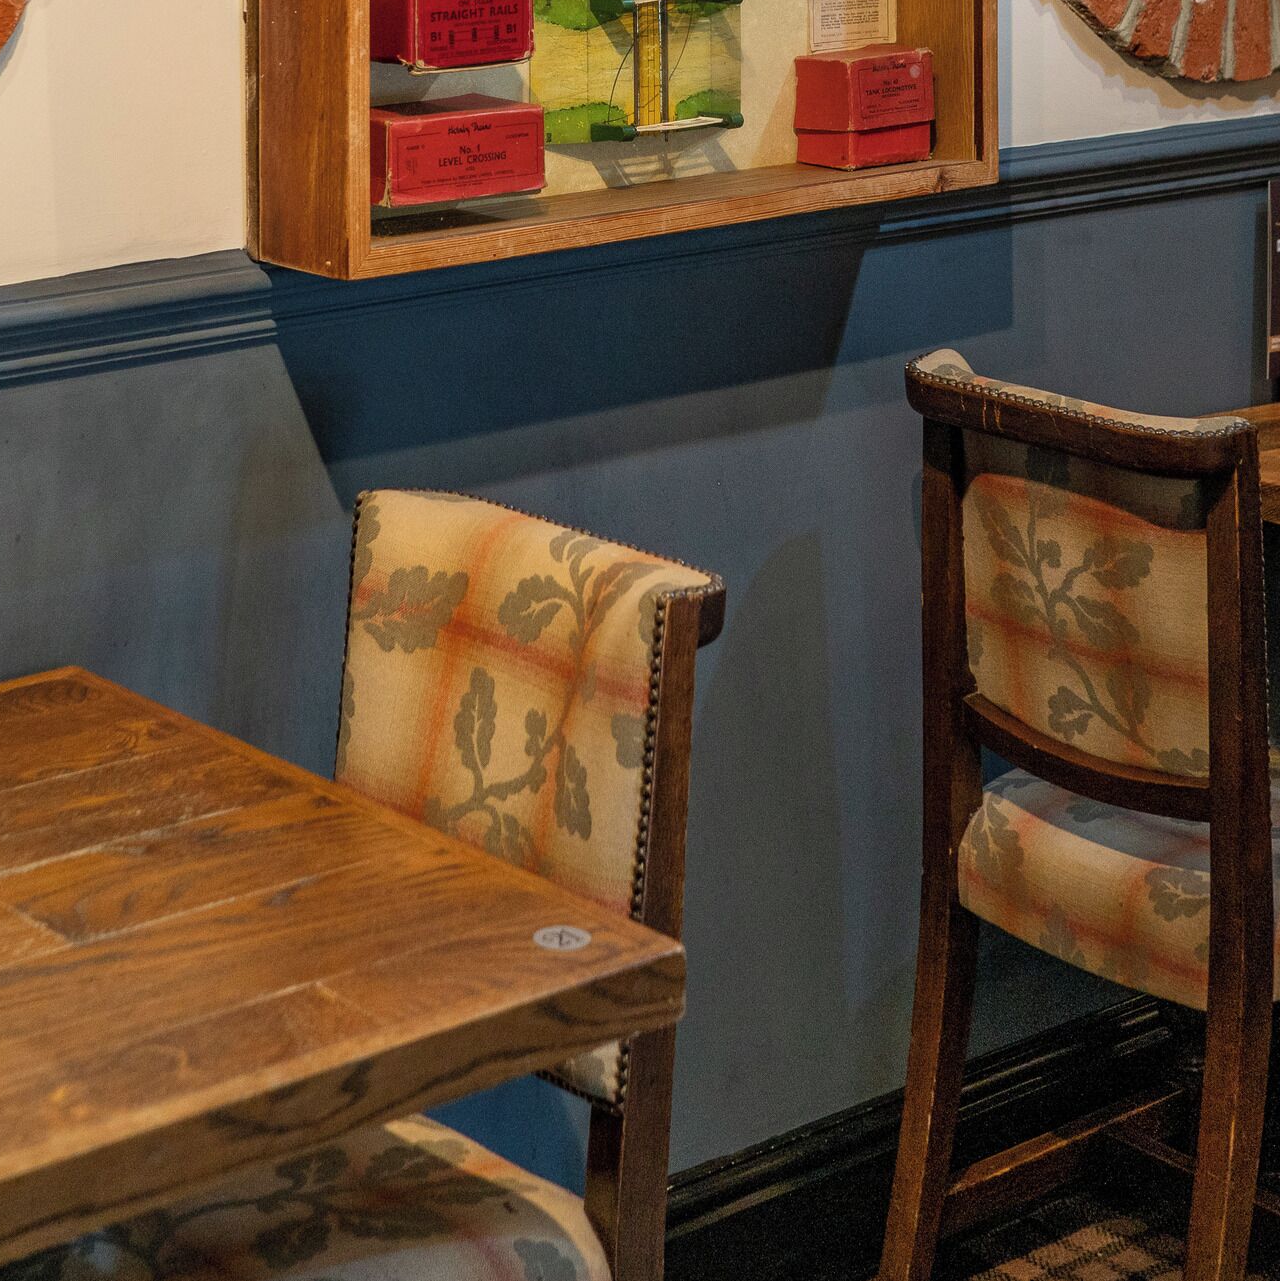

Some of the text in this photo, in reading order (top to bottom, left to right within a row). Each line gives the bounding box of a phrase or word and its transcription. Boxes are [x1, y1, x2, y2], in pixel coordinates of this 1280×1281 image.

[430, 3, 519, 22] STRAIGHT RAILS
[881, 83, 918, 94] LOCOMOTIVE
[460, 145, 472, 155] No.
[438, 151, 507, 168] LEVEL CROSSING
